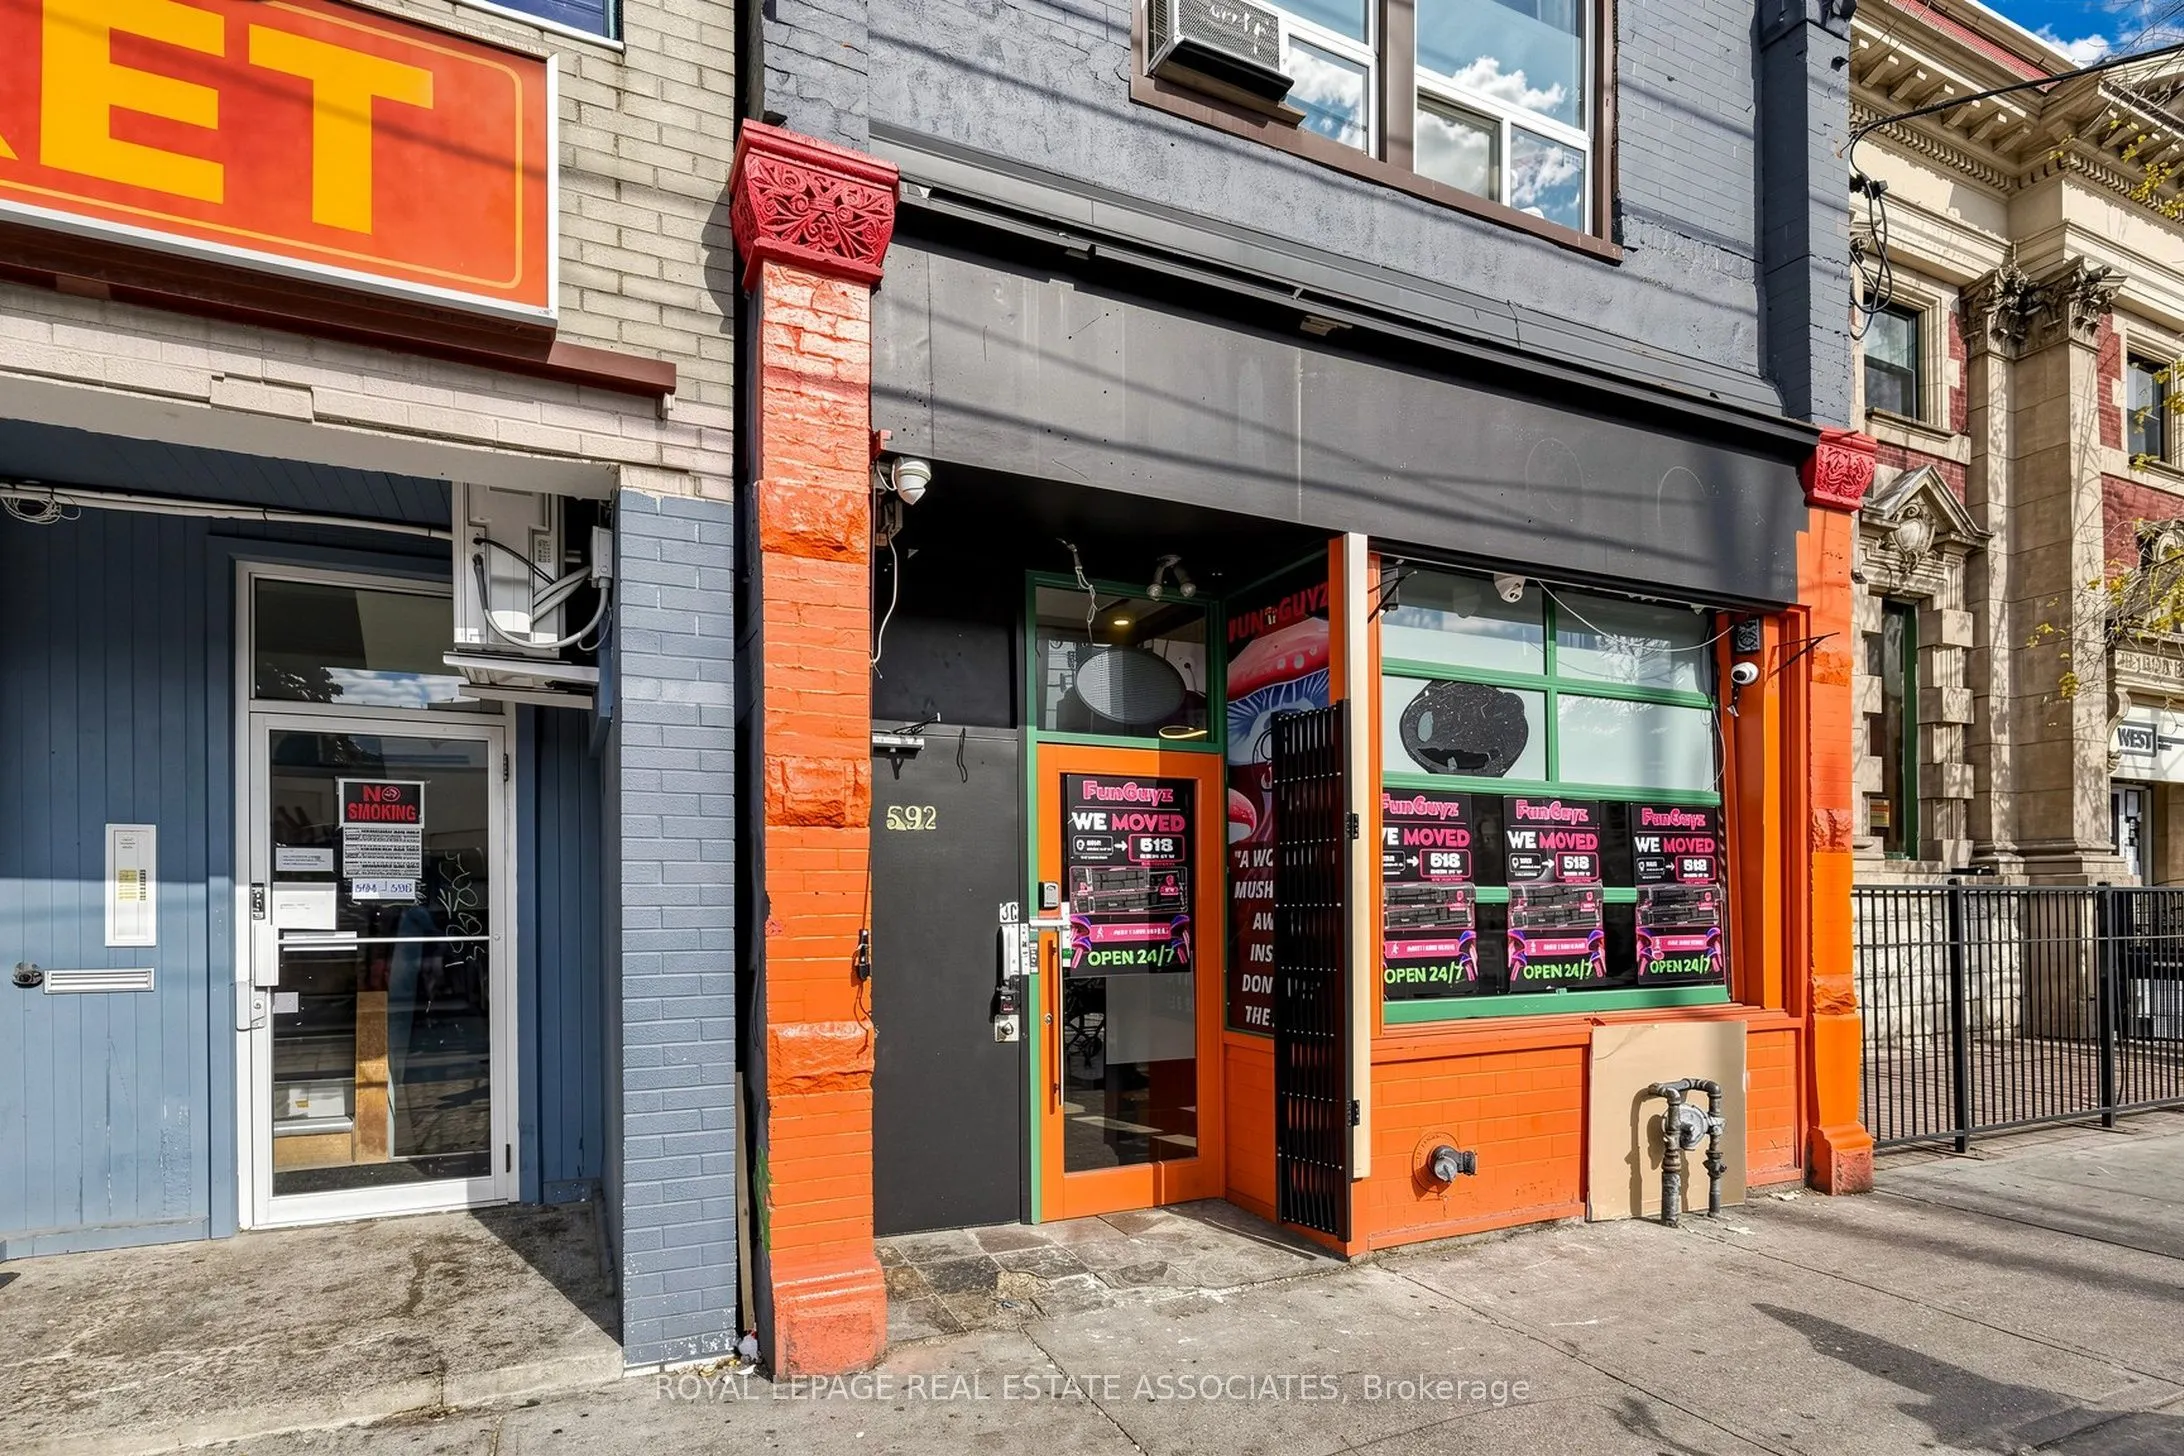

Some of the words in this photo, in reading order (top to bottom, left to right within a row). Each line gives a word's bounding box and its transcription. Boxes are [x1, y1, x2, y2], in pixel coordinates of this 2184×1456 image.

[0, 0, 434, 235] ET
[2117, 726, 2152, 751] WEST
[1082, 780, 1174, 807] FunGuyz
[347, 802, 417, 821] SMOKING
[886, 805, 937, 831] 592
[1071, 811, 1108, 831] WE
[1111, 813, 1186, 832] MOVED
[1515, 799, 1589, 825] FunGuyz
[1402, 828, 1471, 848] MOVED
[1506, 830, 1538, 849] WE
[1538, 831, 1599, 851] MOVED
[1634, 836, 1661, 853] WE
[1663, 837, 1716, 853] MOVED
[1234, 881, 1274, 899] MUSH
[1087, 948, 1135, 967] OPEN
[1137, 944, 1175, 968] 24/7
[1250, 944, 1274, 962] INS
[1383, 966, 1427, 984] OPEN
[1429, 961, 1465, 984] 24/7
[1523, 964, 1563, 980] OPEN
[1564, 958, 1593, 980] 24/7
[1649, 959, 1683, 974] OPEN
[1683, 954, 1711, 975] 24/7
[1242, 974, 1273, 994] DON
